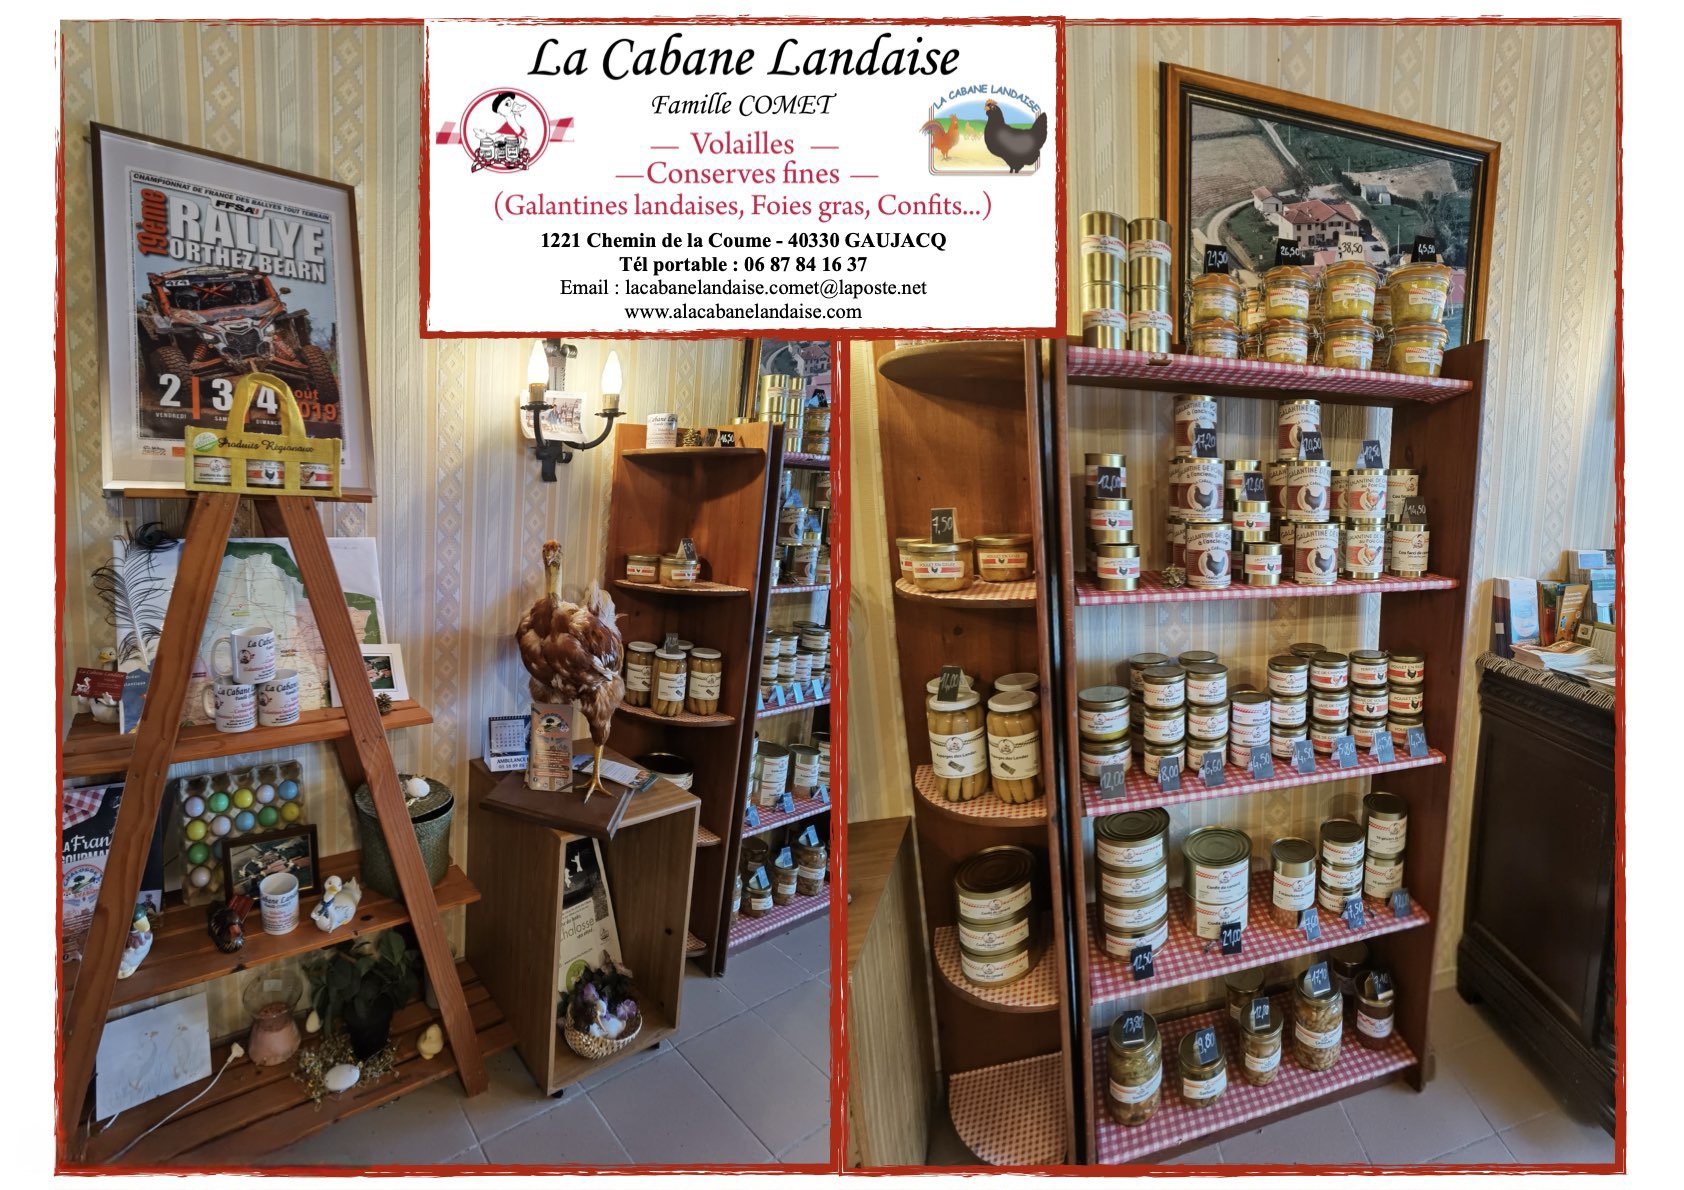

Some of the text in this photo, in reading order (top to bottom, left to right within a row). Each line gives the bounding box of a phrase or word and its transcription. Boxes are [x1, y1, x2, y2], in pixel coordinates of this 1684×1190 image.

[134, 173, 329, 221] CHAMPIONNAT DE FRANCE DES RALLYES TOUT TERRAIN
[170, 196, 324, 263] RALLYE
[1280, 245, 1301, 259] 26,50
[1341, 242, 1364, 256] 38,50
[170, 238, 325, 282] ORTHEZ BEARN
[1207, 250, 1229, 268] 21,50
[159, 373, 278, 415] 2 3 4
[155, 412, 187, 421] VENDREDI
[255, 419, 281, 427] DIMANC
[299, 401, 338, 423] 019
[218, 436, 260, 451] Produits
[1160, 764, 1179, 782] 8,00
[1204, 758, 1222, 775] 6,60
[560, 918, 595, 942] halosse
